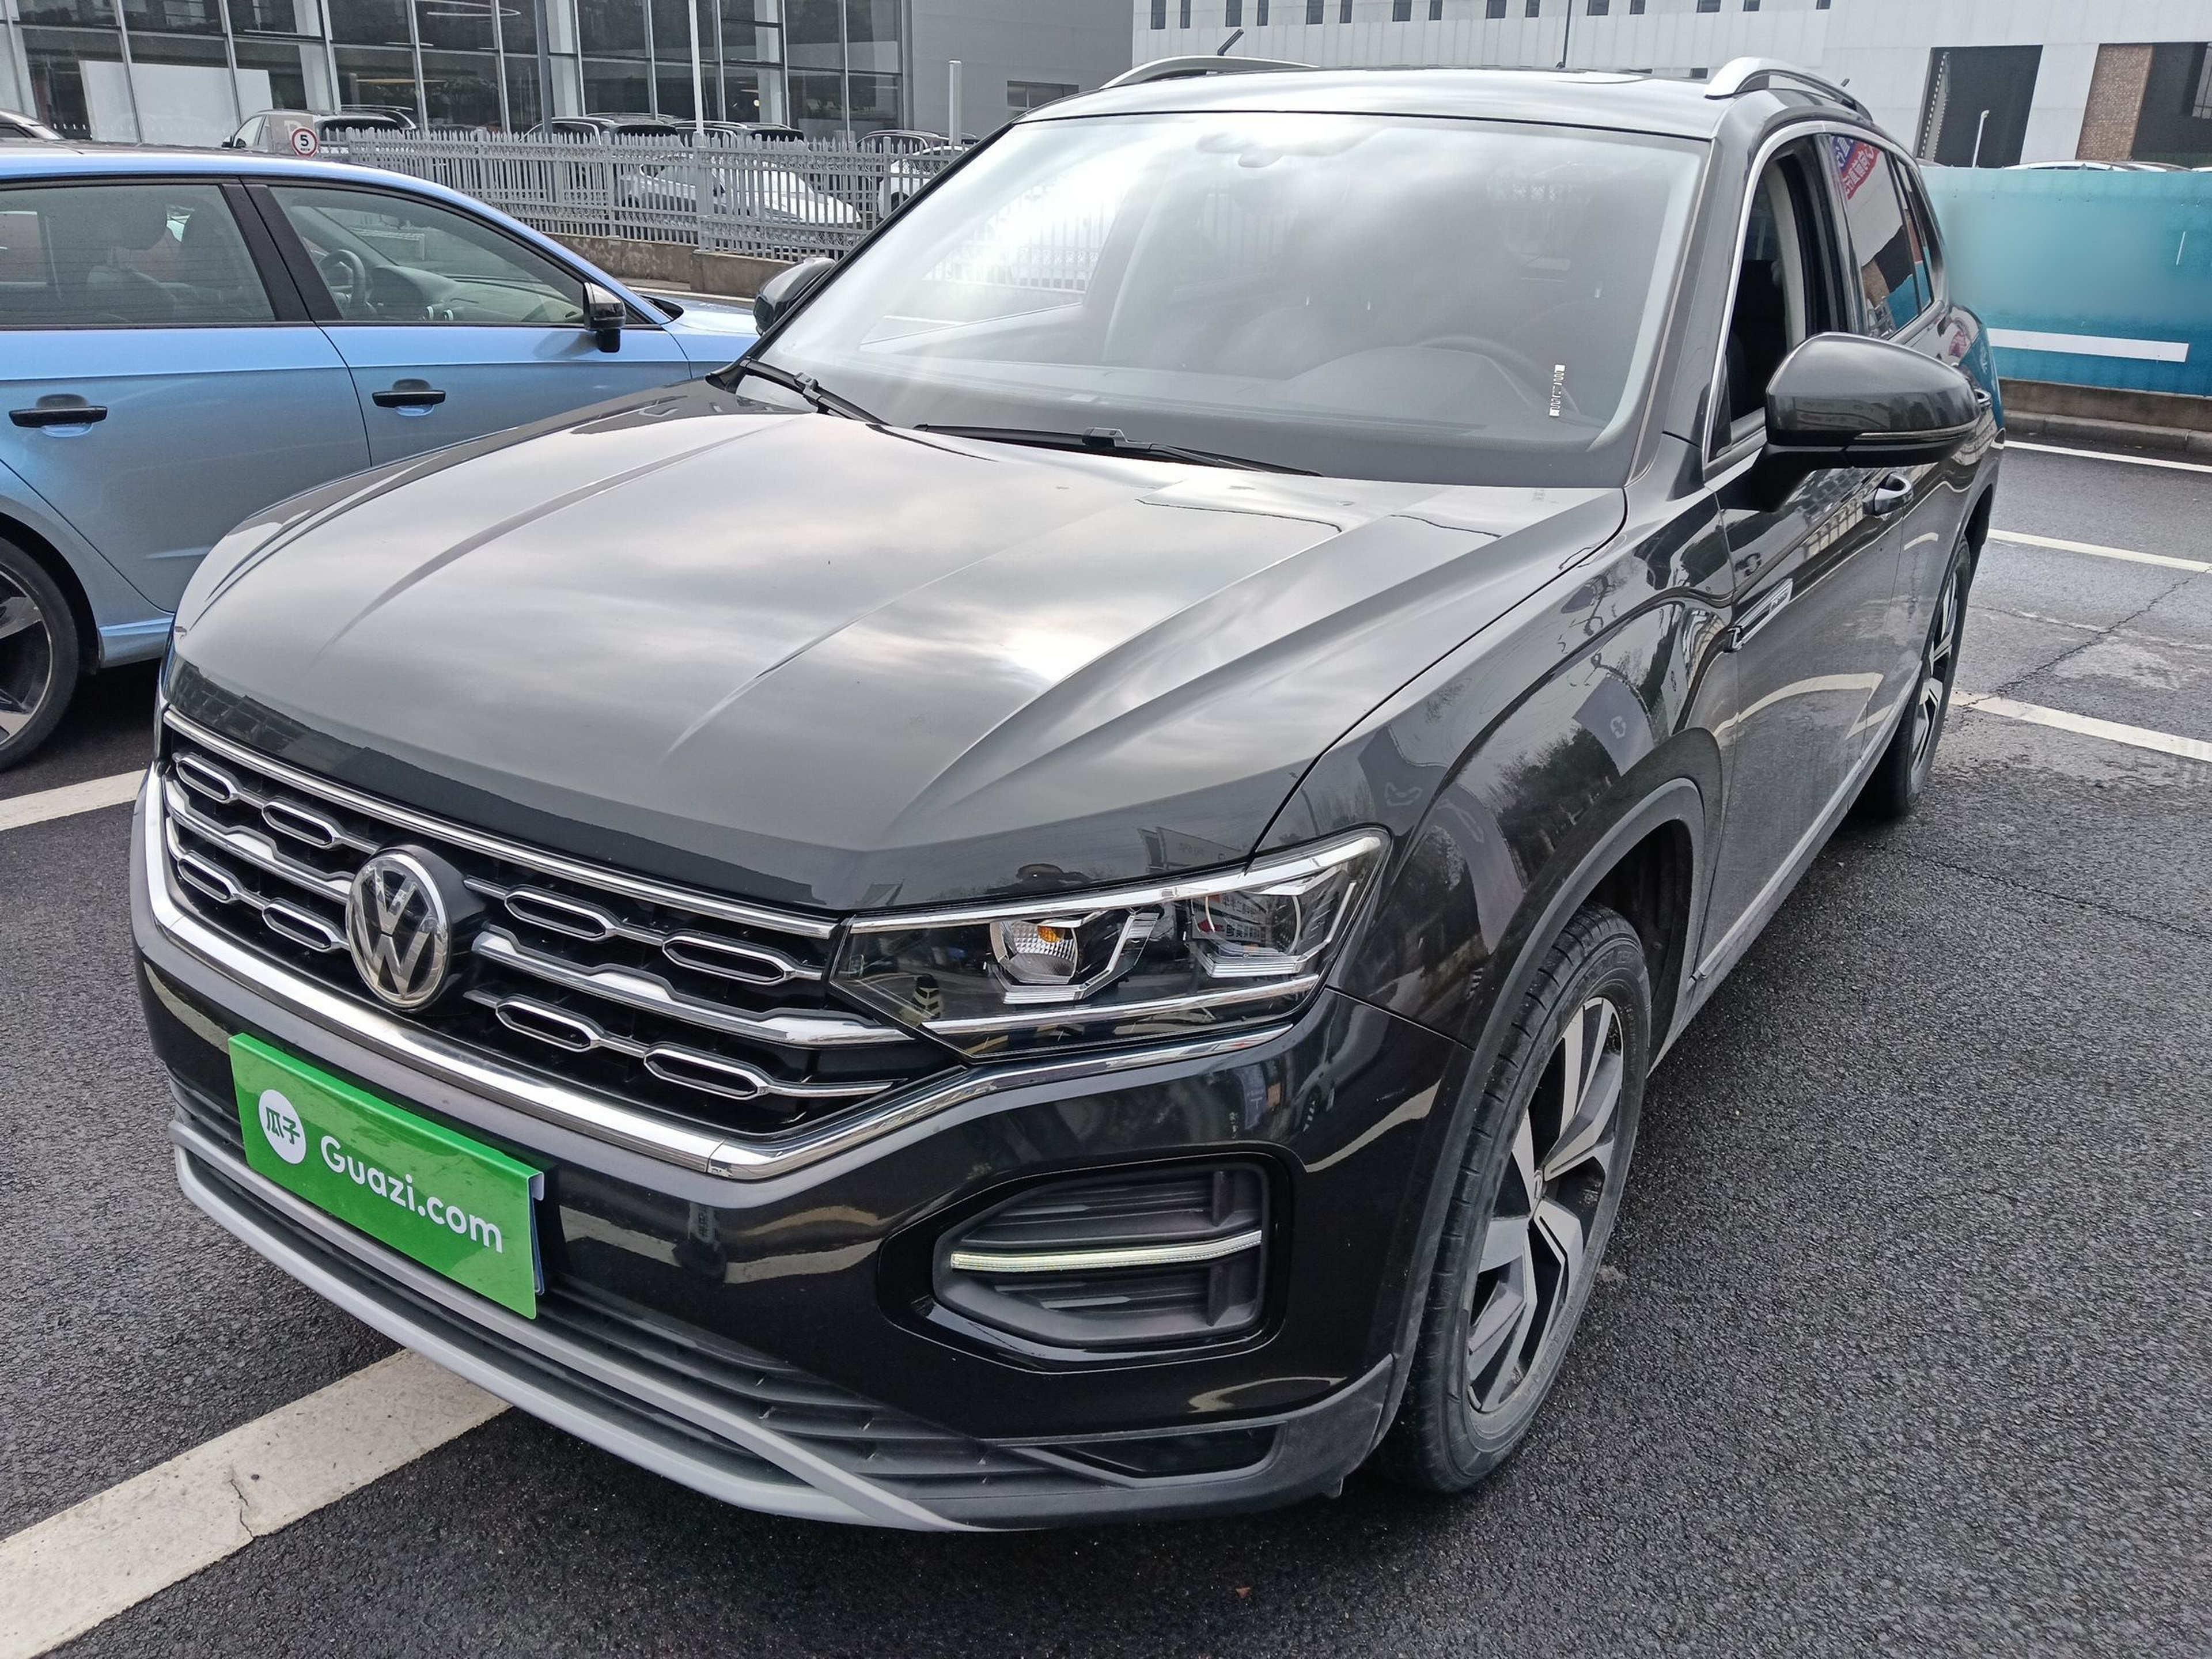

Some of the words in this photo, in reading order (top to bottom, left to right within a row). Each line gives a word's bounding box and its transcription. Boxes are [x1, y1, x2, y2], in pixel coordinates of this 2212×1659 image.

[300, 134, 309, 146] 5
[265, 1106, 300, 1145] 瓜子
[320, 1135, 503, 1253] Guazi.com
